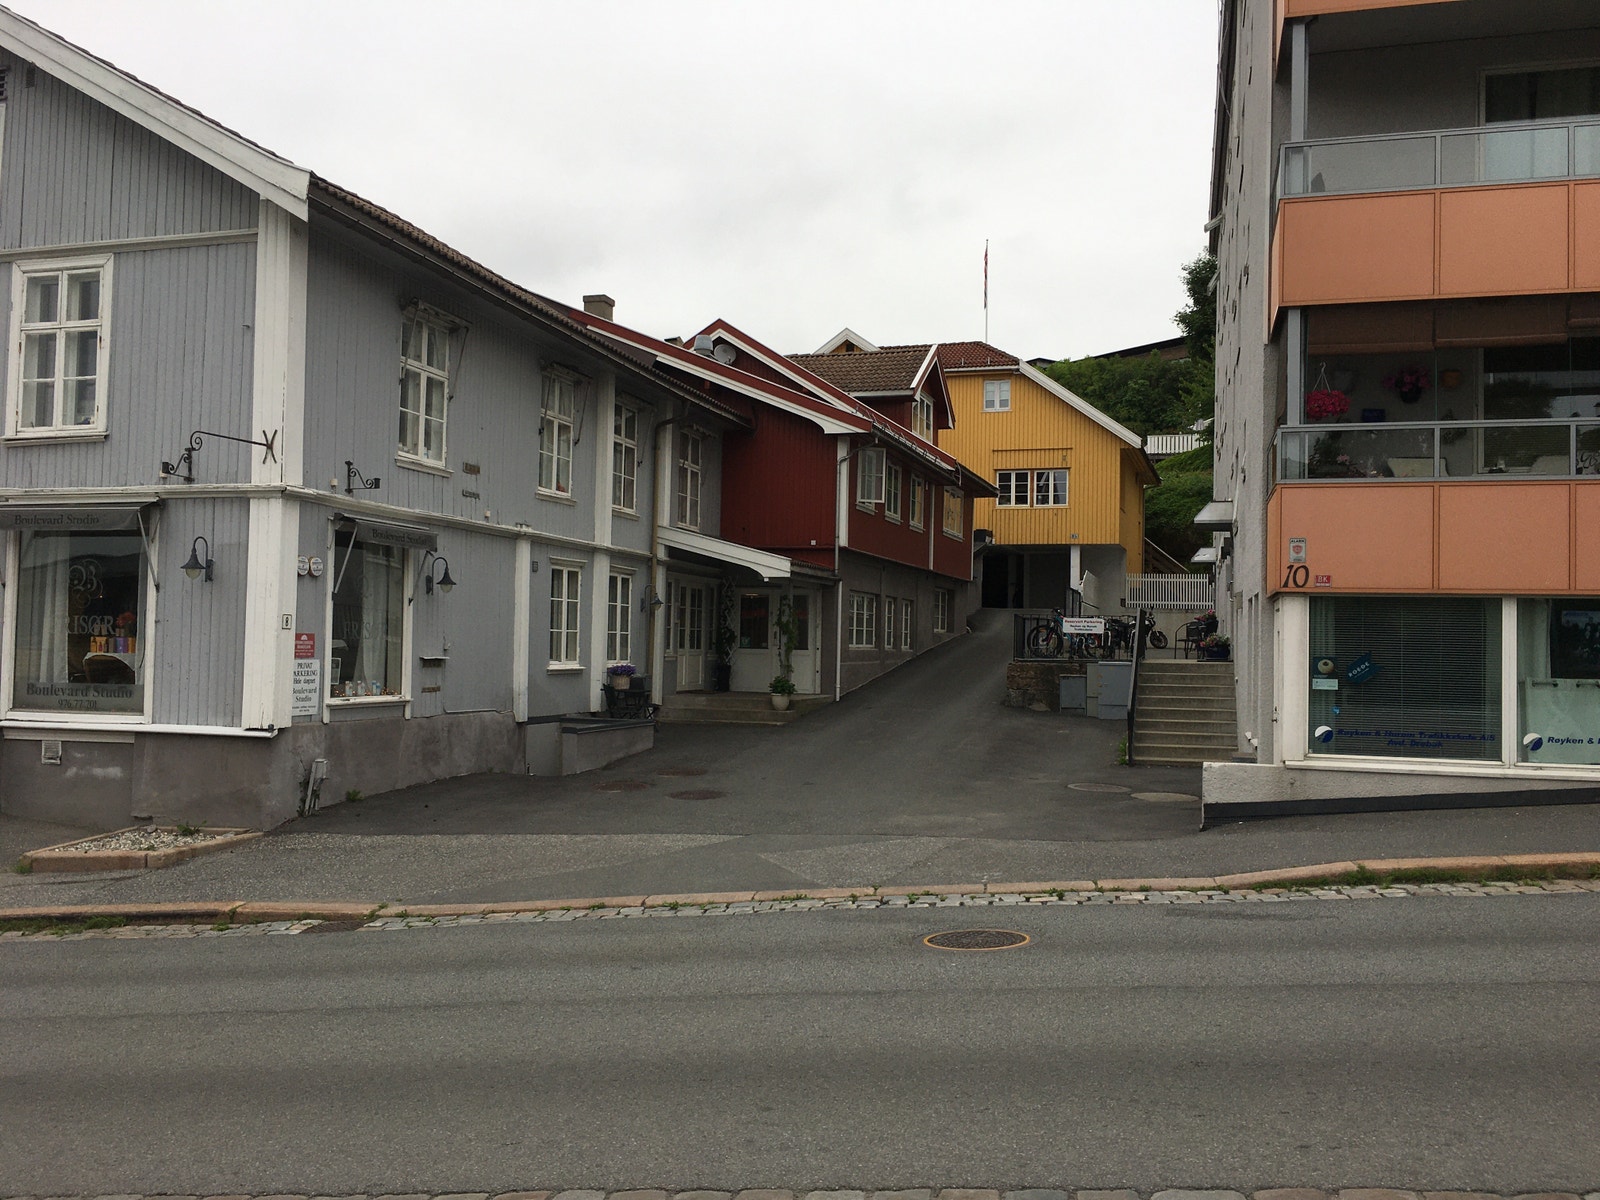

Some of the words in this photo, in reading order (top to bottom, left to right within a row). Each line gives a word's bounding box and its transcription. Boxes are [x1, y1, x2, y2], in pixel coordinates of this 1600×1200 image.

[15, 514, 63, 525] Boulevard
[66, 514, 99, 525] Studio
[372, 528, 405, 543] Boulevard
[1282, 564, 1310, 588] 10
[1317, 575, 1328, 583] BK
[293, 669, 318, 677] ARKERING
[26, 682, 89, 697] Boulevard
[92, 686, 133, 698] Studio
[295, 695, 312, 703] Studio
